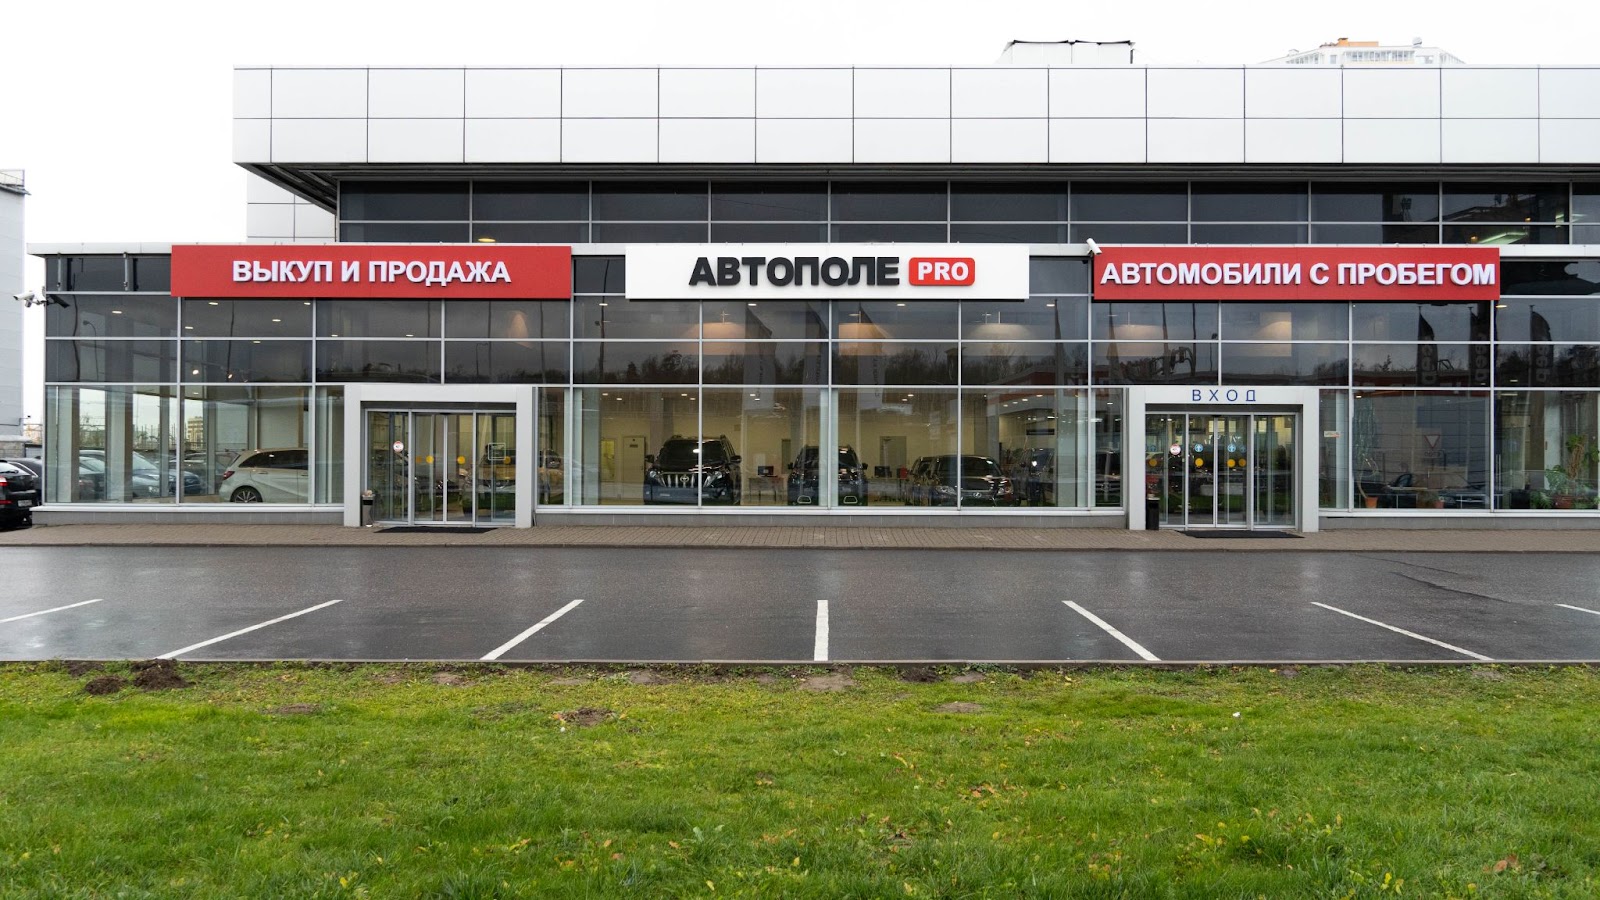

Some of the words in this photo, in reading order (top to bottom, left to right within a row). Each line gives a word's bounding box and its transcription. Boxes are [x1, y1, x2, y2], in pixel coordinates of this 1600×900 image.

[232, 260, 334, 283] ВЫКУП
[340, 260, 361, 283] И
[367, 260, 512, 287] ПРОДАЖА
[689, 257, 899, 286] АВТОПОЛЕ
[917, 262, 969, 283] PRO
[1100, 262, 1302, 286] АВТОМОБИЛИ
[1309, 262, 1331, 285] С
[1337, 262, 1497, 287] ПРОБЕГОМ
[1192, 389, 1257, 402] ВХОД
